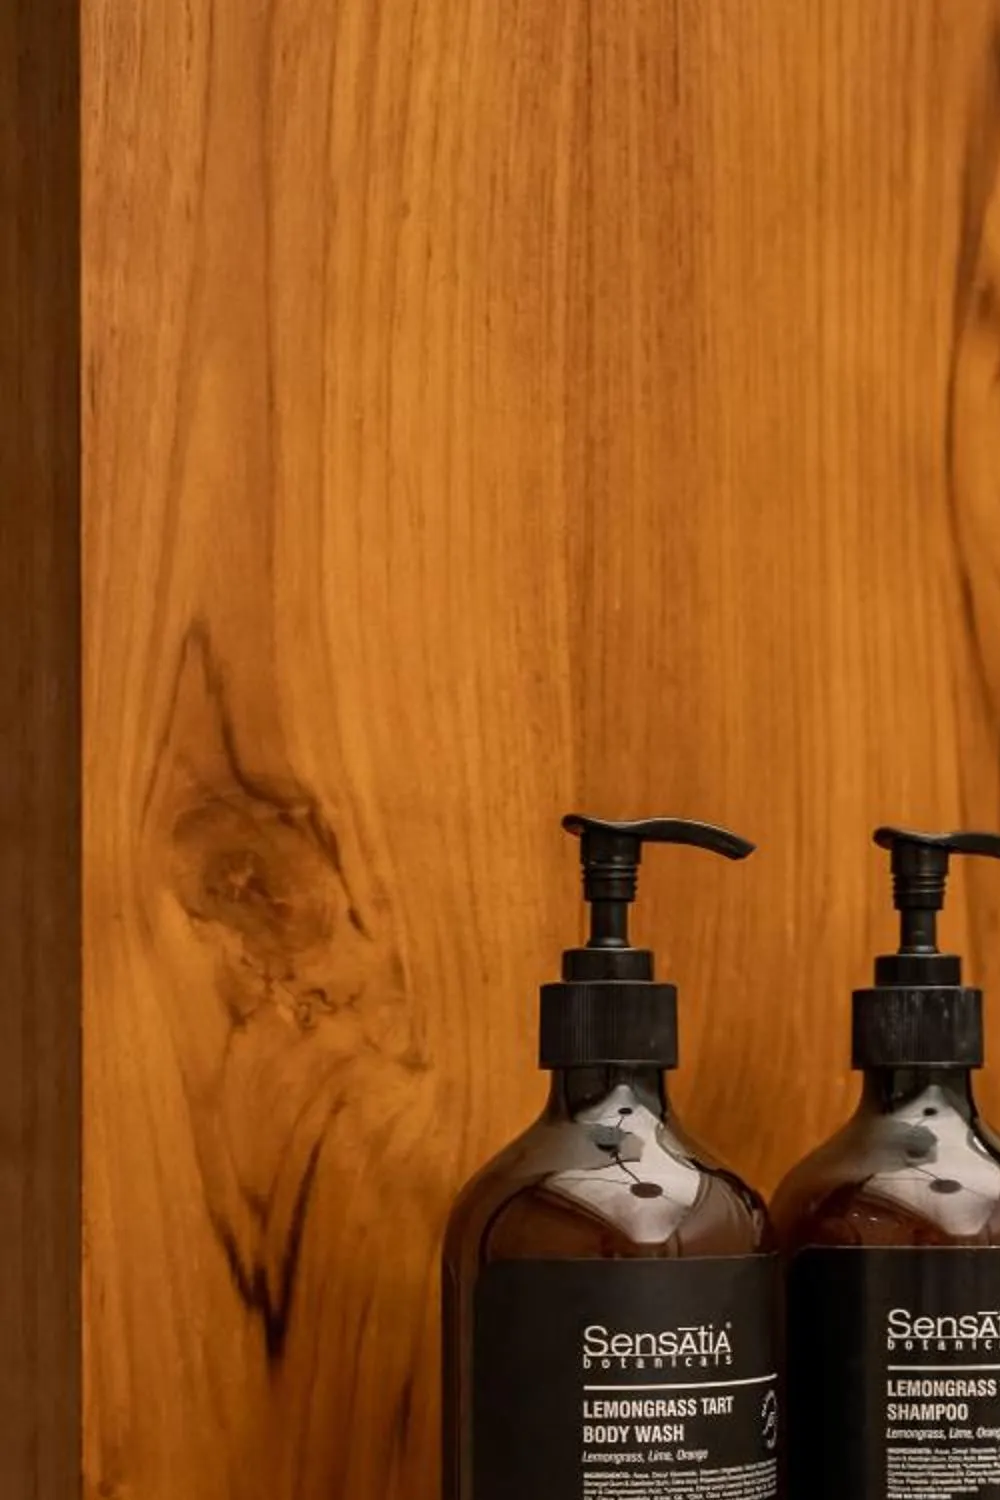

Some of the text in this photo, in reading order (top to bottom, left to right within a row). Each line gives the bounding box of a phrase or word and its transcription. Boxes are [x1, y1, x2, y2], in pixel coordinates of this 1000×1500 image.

[583, 1354, 732, 1369] botanicals
[887, 1378, 998, 1397] LEMONGRASS
[583, 1396, 734, 1419] LEMONGRASS TART
[887, 1403, 969, 1421] SHAMPOO
[583, 1423, 685, 1444] BODY WASH
